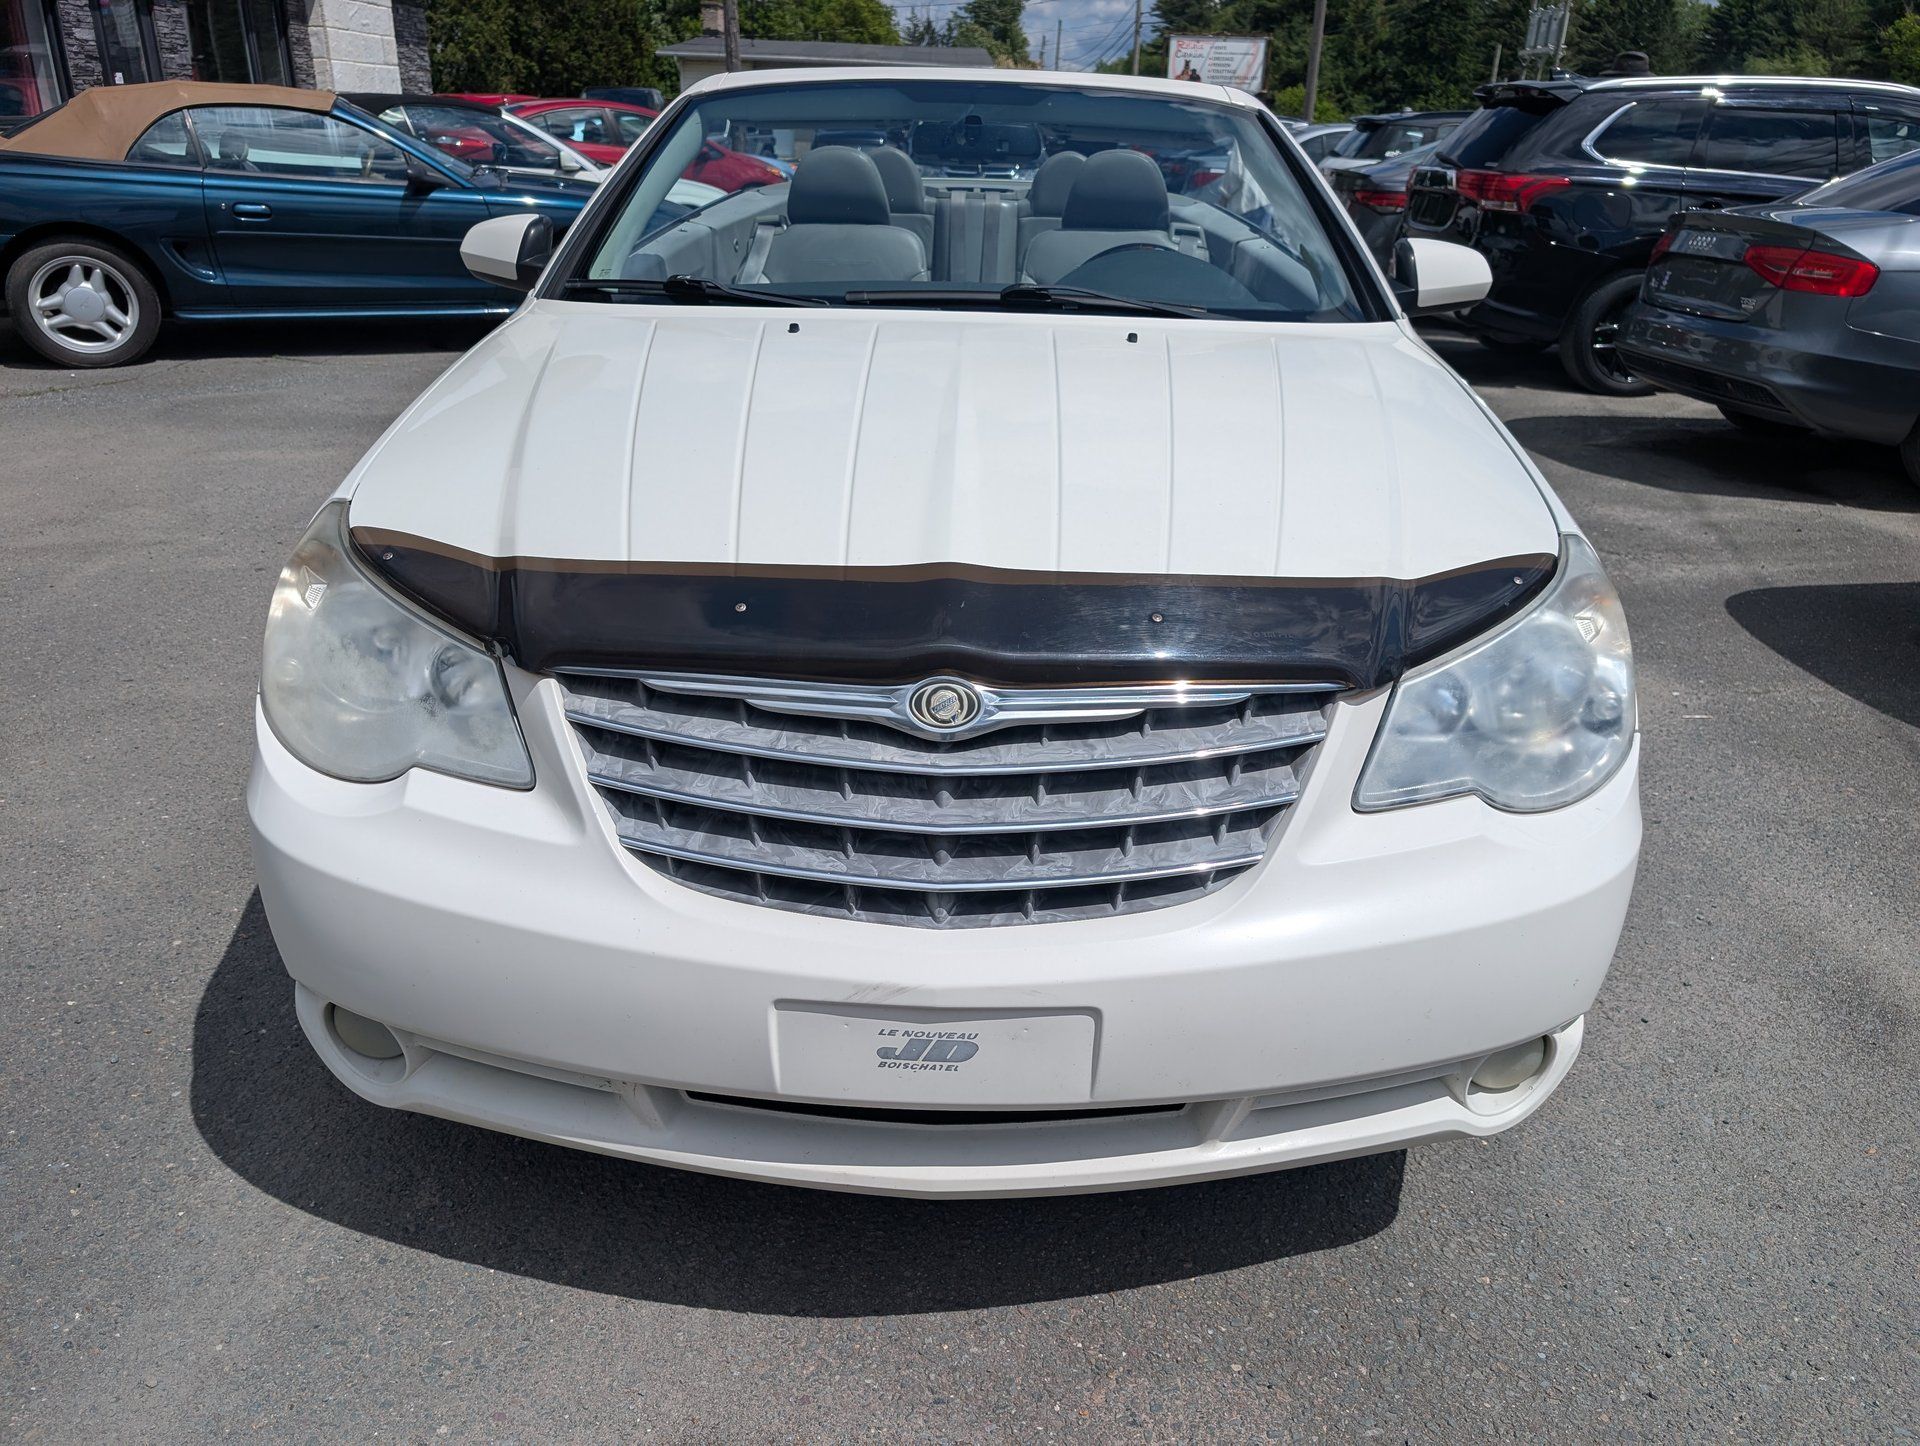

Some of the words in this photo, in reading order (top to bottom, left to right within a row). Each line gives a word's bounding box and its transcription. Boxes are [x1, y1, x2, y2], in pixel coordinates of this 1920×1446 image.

[878, 1028, 899, 1037] LE
[901, 1030, 979, 1040] NOUVEAU
[876, 1038, 980, 1063] JD
[877, 1061, 960, 1072] BOISCHATEL
